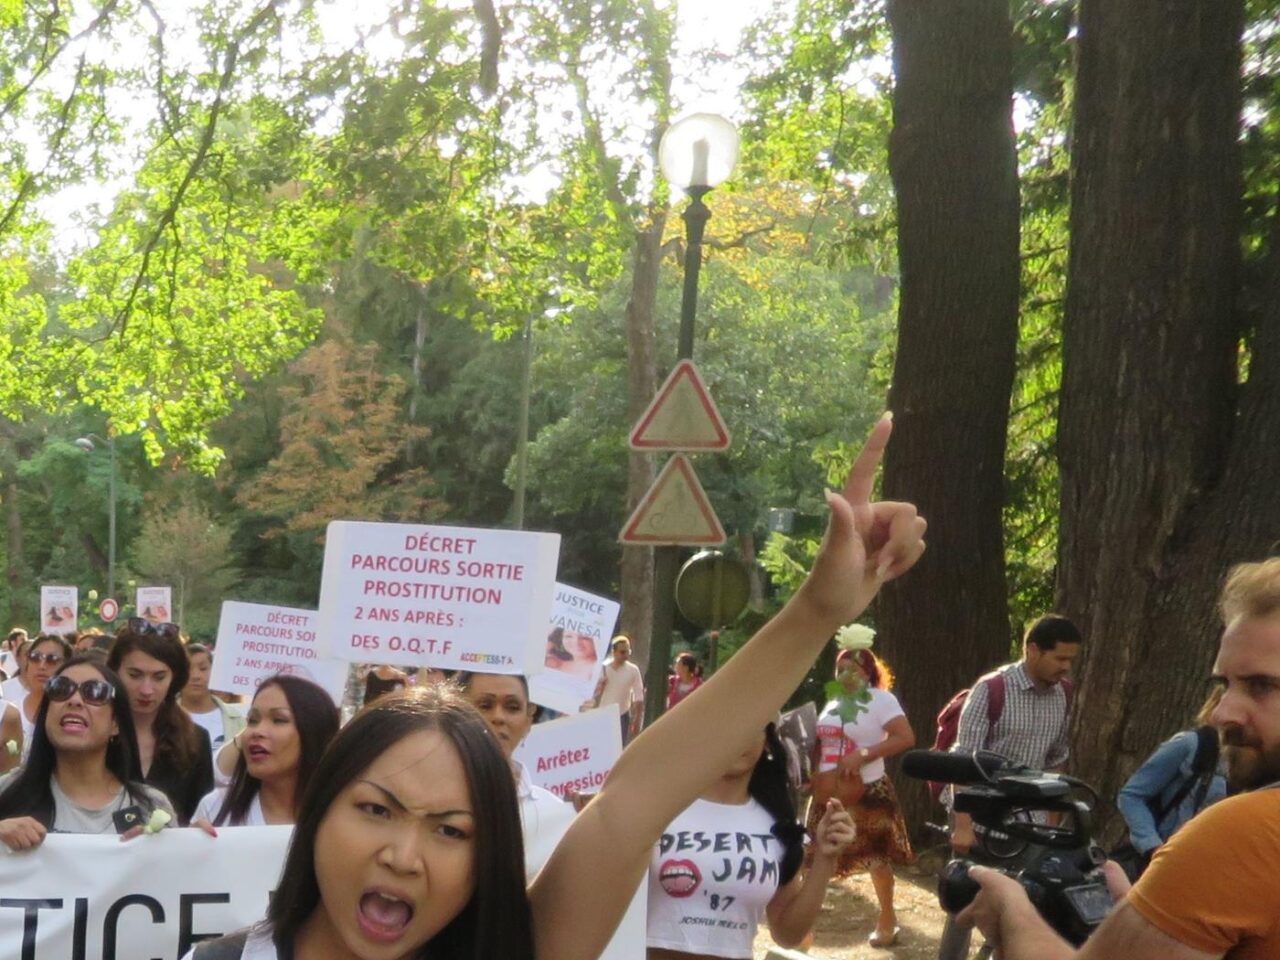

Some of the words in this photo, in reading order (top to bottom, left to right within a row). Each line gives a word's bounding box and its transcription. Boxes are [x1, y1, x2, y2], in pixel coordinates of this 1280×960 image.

[405, 532, 477, 555] DÉCRET
[351, 554, 450, 576] PARCOURS
[456, 560, 524, 581] SORTIE
[364, 580, 502, 605] PROSTITUTION
[556, 591, 605, 615] JUSTICE
[267, 612, 309, 626] DÉCRET
[354, 606, 363, 620] 2
[368, 608, 400, 622] ANS
[403, 608, 454, 627] APRÈS
[236, 623, 293, 640] PARCOURS
[242, 640, 317, 659] PROSTITUTIO
[351, 634, 380, 649] DES
[388, 636, 452, 655] O.Q.T.F
[244, 658, 262, 669] ANS
[537, 748, 590, 773] Arrêtez
[659, 831, 776, 857] DESERT
[712, 856, 777, 886] JAM
